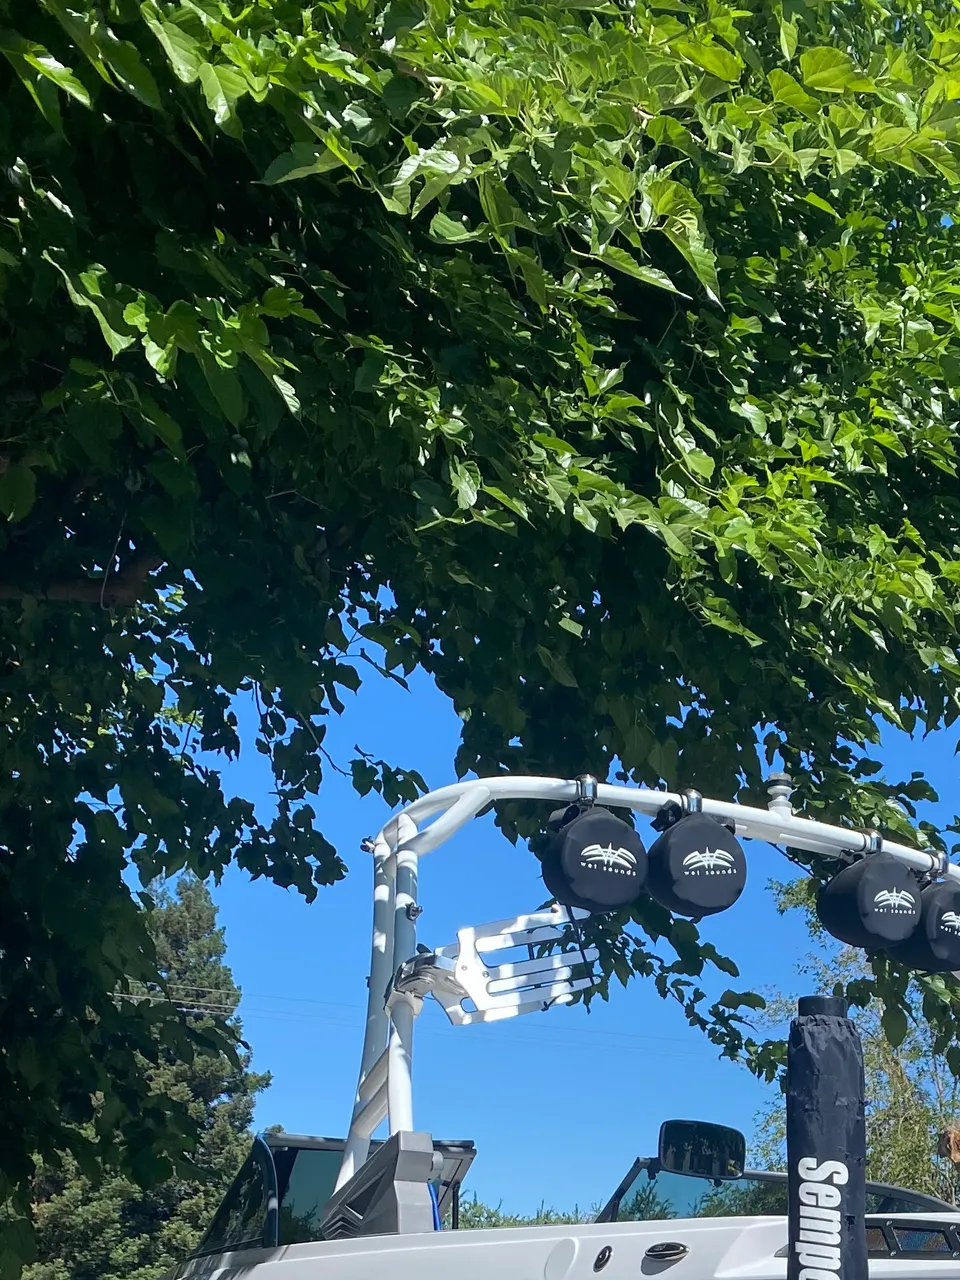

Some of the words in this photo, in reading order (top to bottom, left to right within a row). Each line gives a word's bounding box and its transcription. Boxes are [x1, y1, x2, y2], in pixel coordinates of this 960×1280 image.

[580, 861, 597, 870] wet
[603, 865, 637, 877] sounds
[705, 868, 737, 876] sounds
